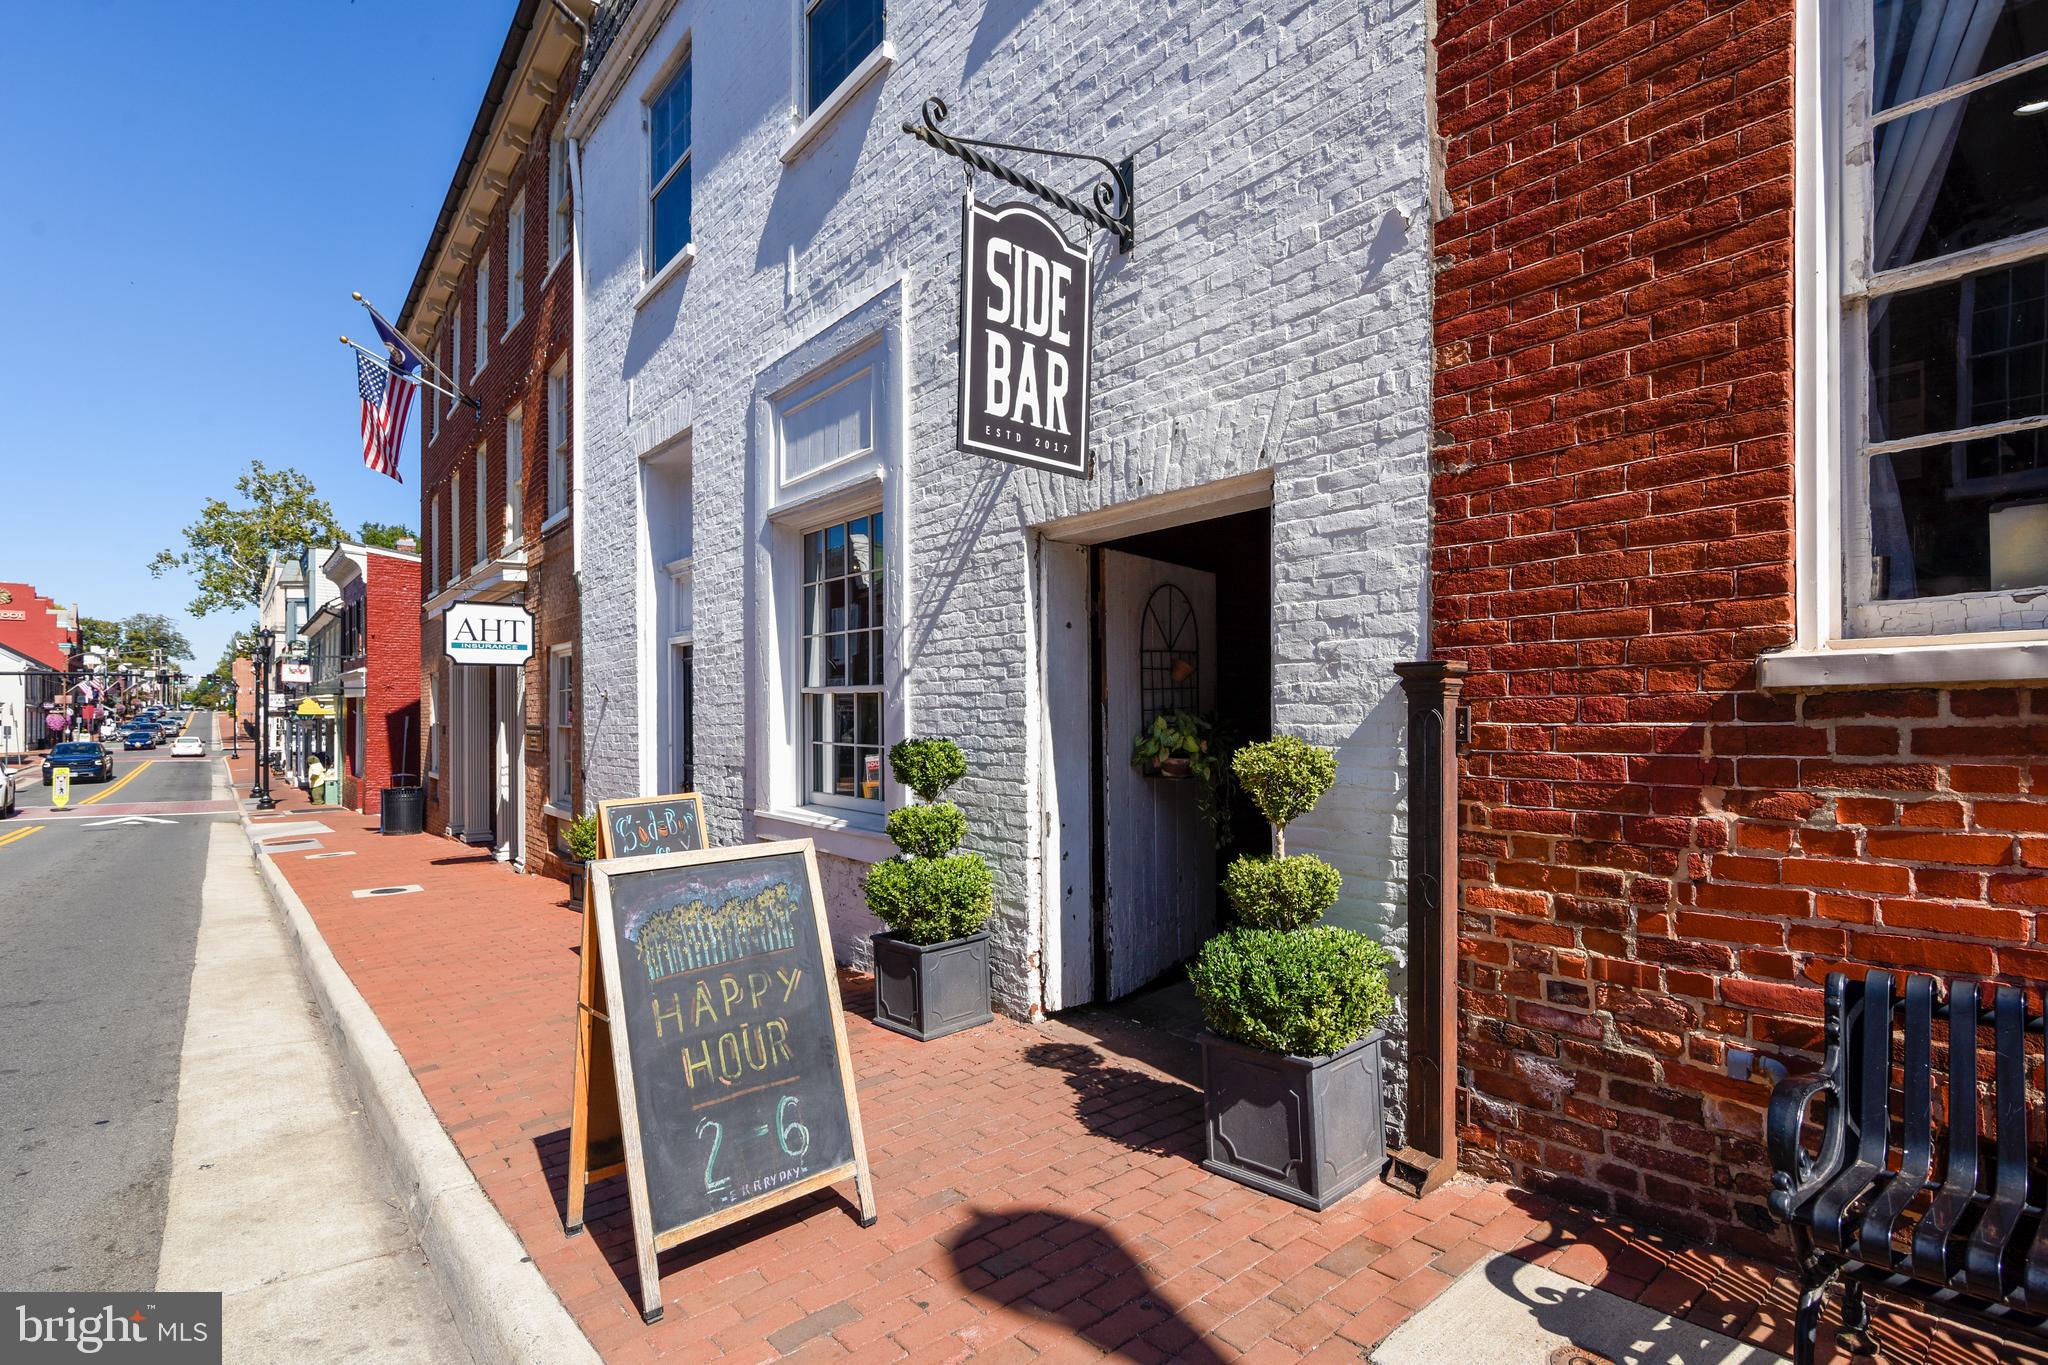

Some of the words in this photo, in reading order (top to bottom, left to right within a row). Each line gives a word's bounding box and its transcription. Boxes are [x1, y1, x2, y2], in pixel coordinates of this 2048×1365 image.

[986, 237, 1072, 347] SIDE
[984, 329, 1071, 436] BAR
[985, 425, 1021, 442] ESTD
[1035, 438, 1068, 453] 2017
[454, 617, 525, 642] AHT
[652, 967, 801, 1038] HAPPY
[681, 1017, 794, 1088] HOUR
